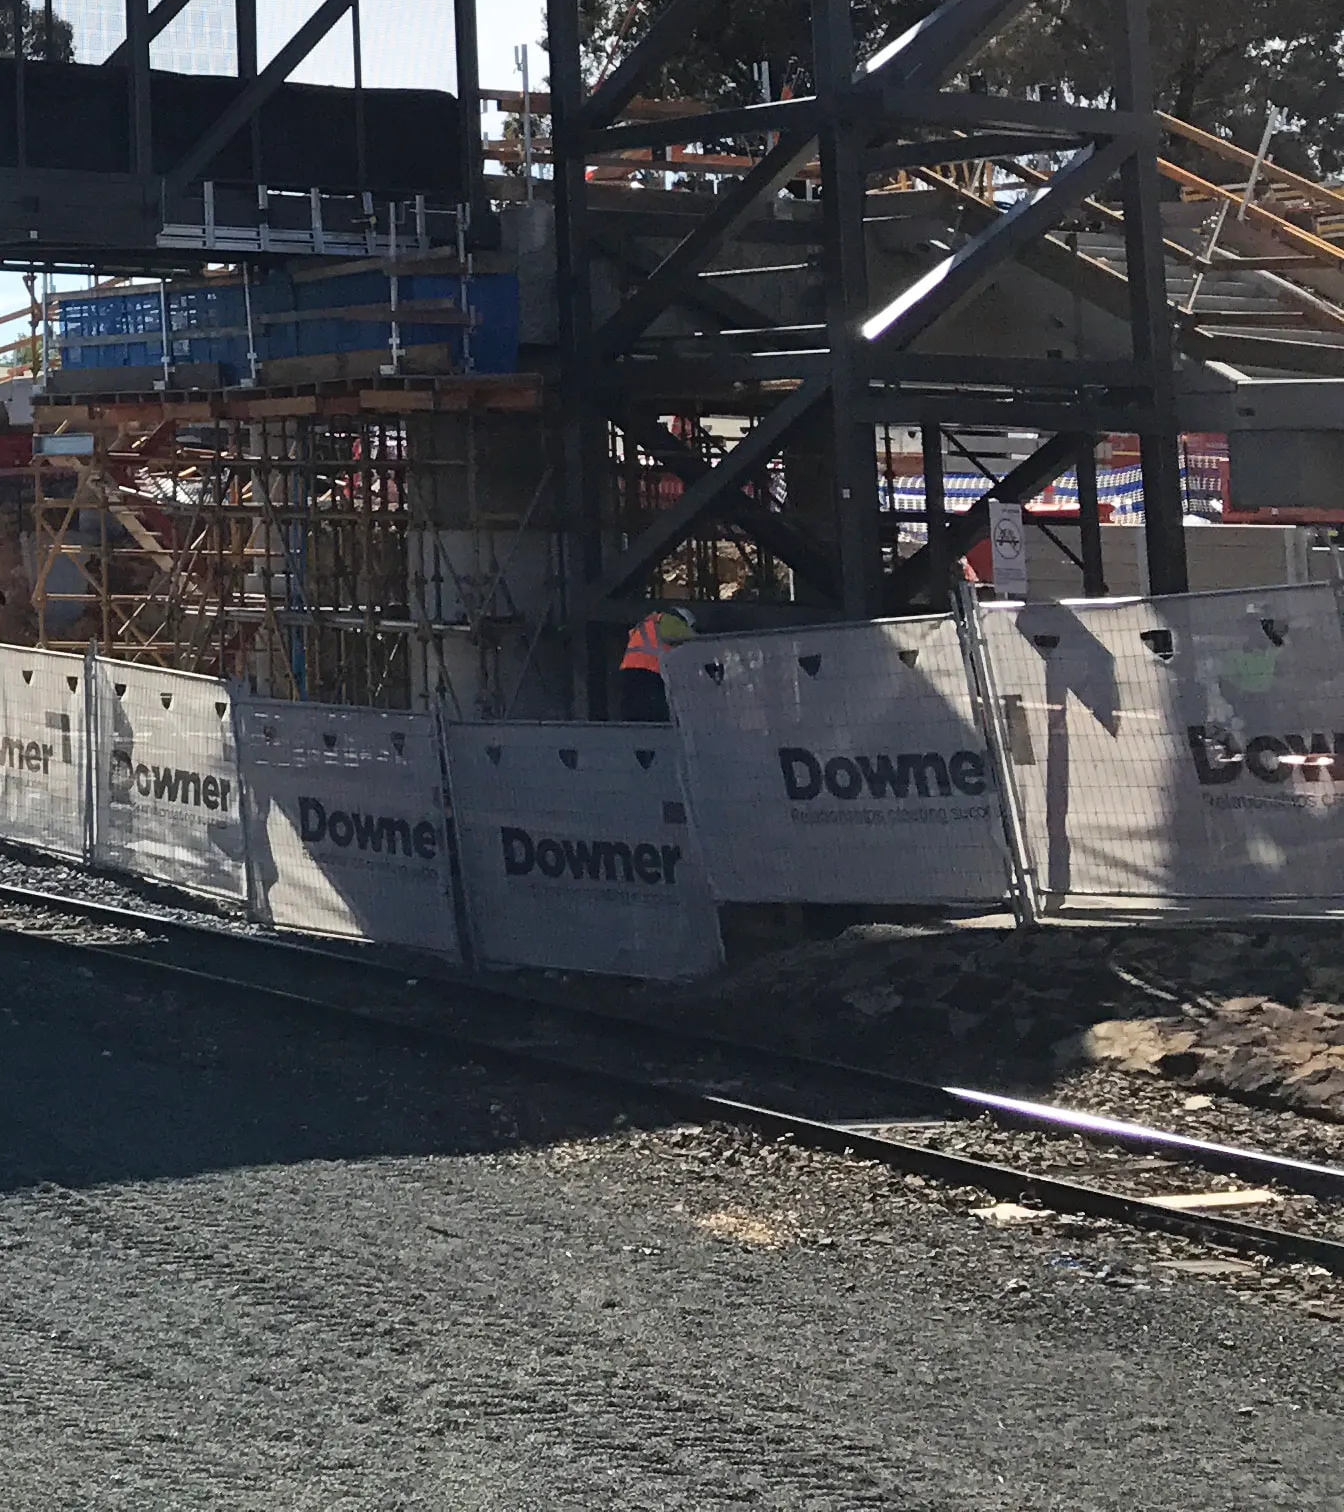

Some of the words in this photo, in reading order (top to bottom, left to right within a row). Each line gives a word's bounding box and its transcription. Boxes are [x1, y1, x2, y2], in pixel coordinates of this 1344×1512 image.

[778, 747, 989, 800] Downe
[298, 796, 439, 859] Downe
[501, 825, 682, 884] Downer
